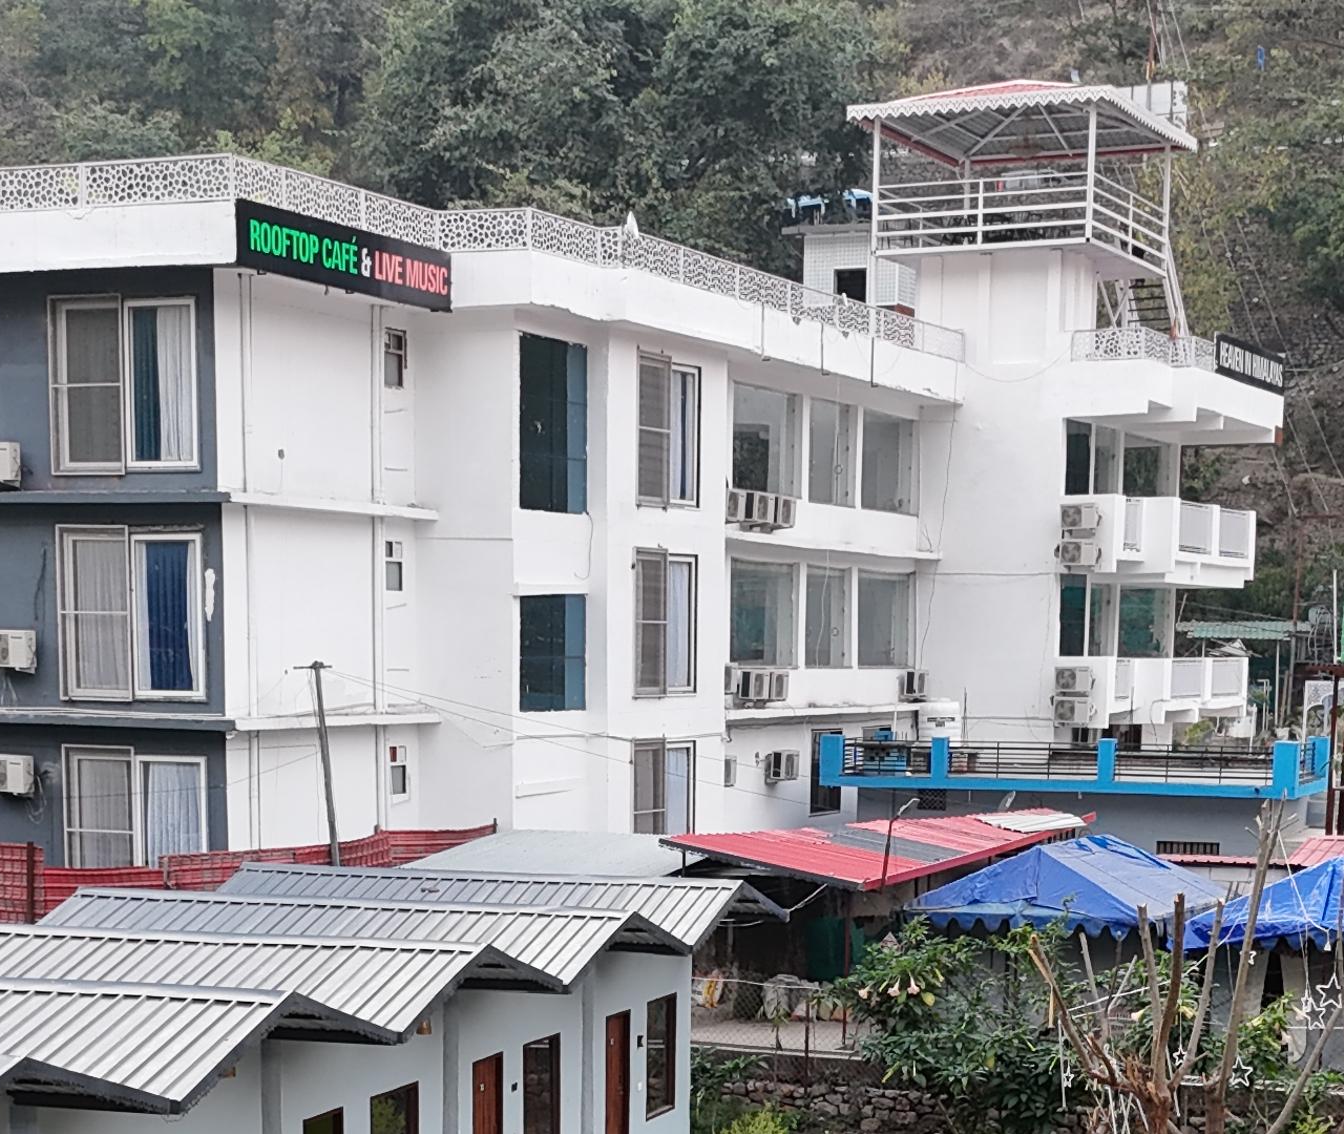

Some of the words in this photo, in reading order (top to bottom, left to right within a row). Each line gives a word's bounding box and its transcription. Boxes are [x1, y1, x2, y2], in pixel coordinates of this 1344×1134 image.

[249, 219, 319, 264] ROOFTOP
[321, 236, 358, 275] CAFÉ
[361, 248, 372, 278] &
[375, 250, 403, 285] LIVE
[406, 258, 448, 296] MUSIC
[1220, 341, 1244, 373] HEAVEN
[1245, 350, 1252, 376] IN
[1252, 354, 1283, 387] HIMALAYAS
